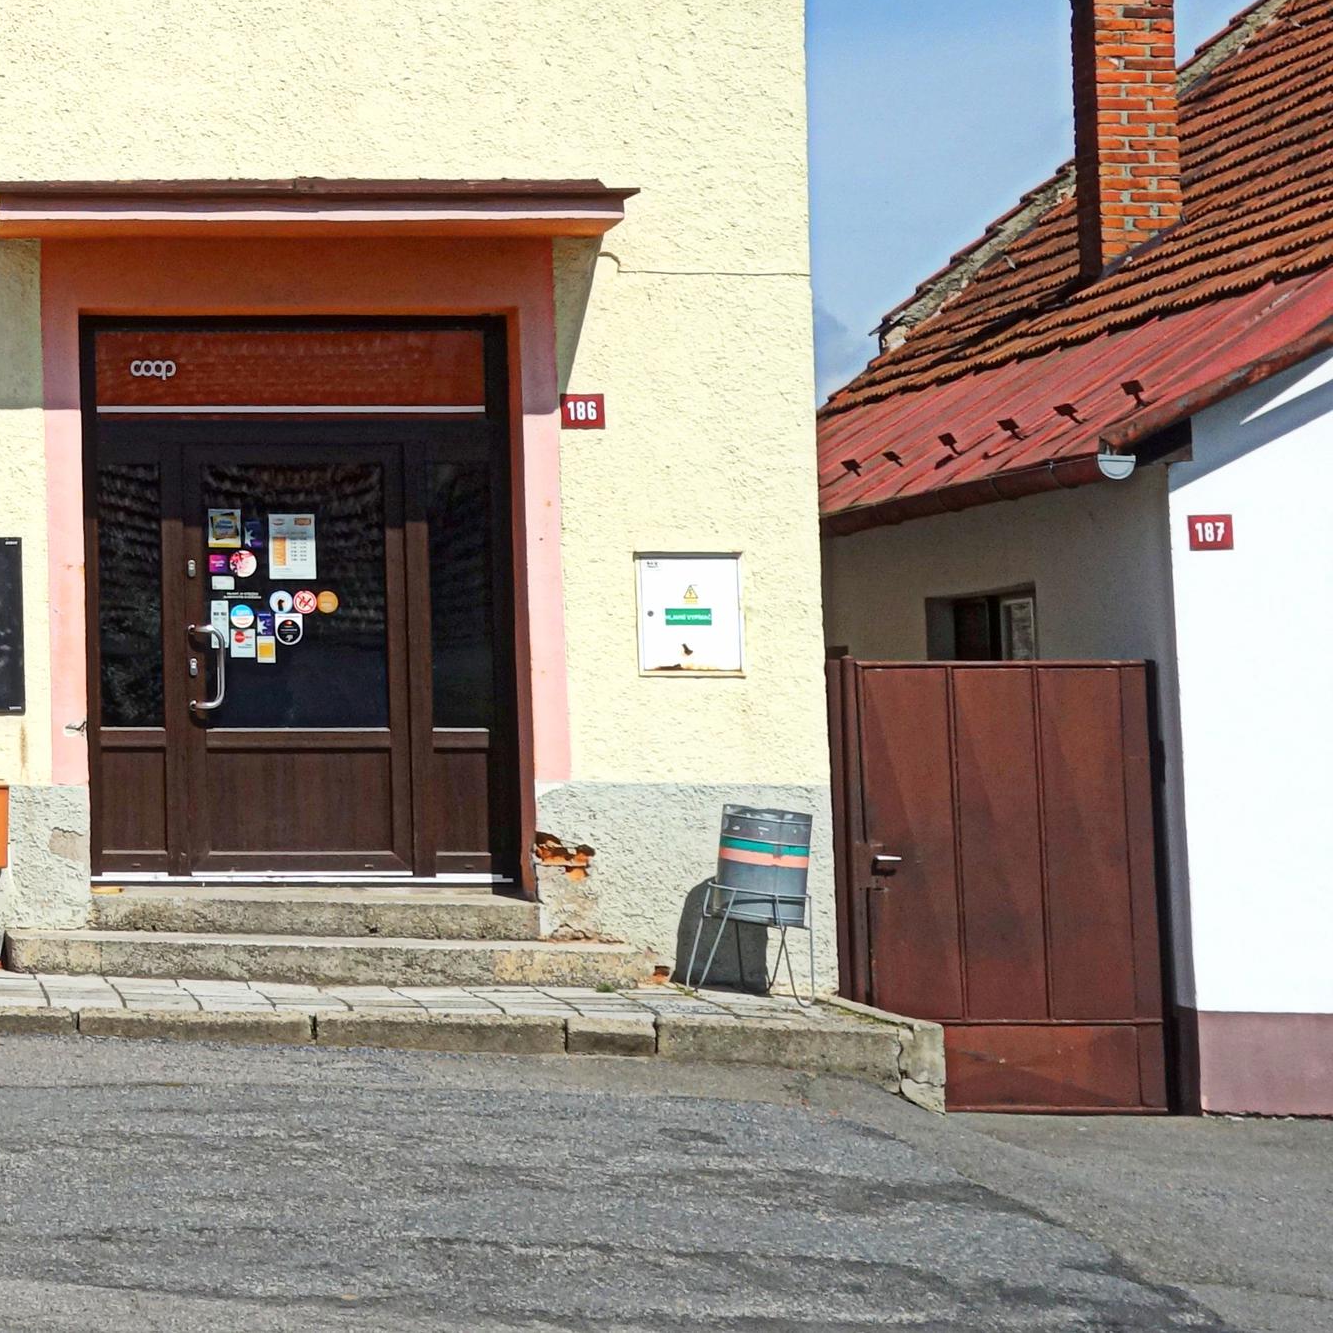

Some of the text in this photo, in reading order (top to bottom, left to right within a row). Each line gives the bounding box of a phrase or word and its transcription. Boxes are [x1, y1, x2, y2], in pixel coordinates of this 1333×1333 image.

[130, 360, 177, 380] coop
[567, 401, 597, 420] 186
[1195, 522, 1225, 542] 187
